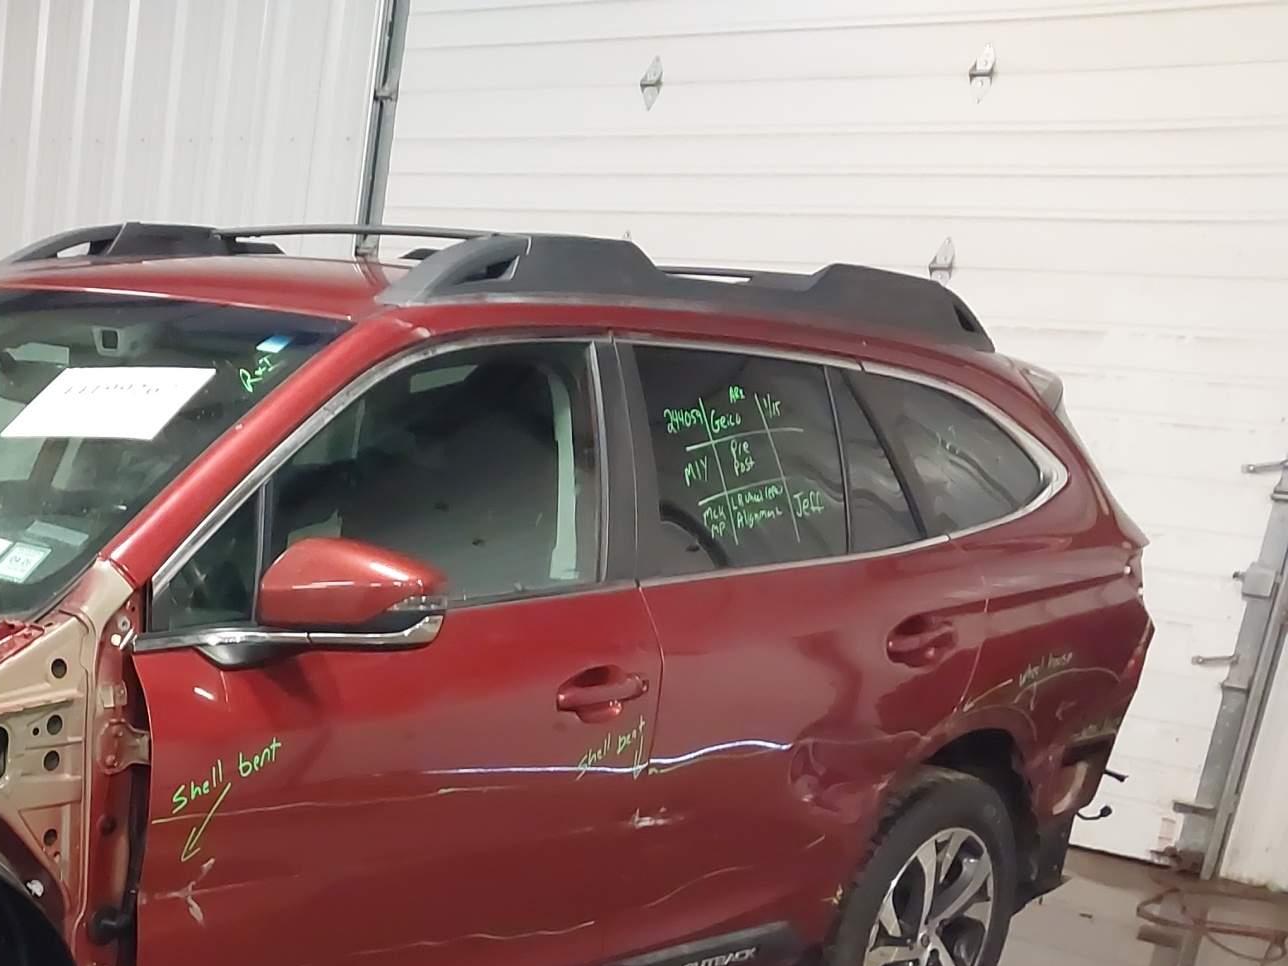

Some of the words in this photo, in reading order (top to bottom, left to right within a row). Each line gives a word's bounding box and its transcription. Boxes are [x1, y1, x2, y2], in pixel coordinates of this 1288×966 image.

[663, 408, 704, 434] 244059
[710, 410, 742, 433] Geico
[238, 736, 282, 777] bent
